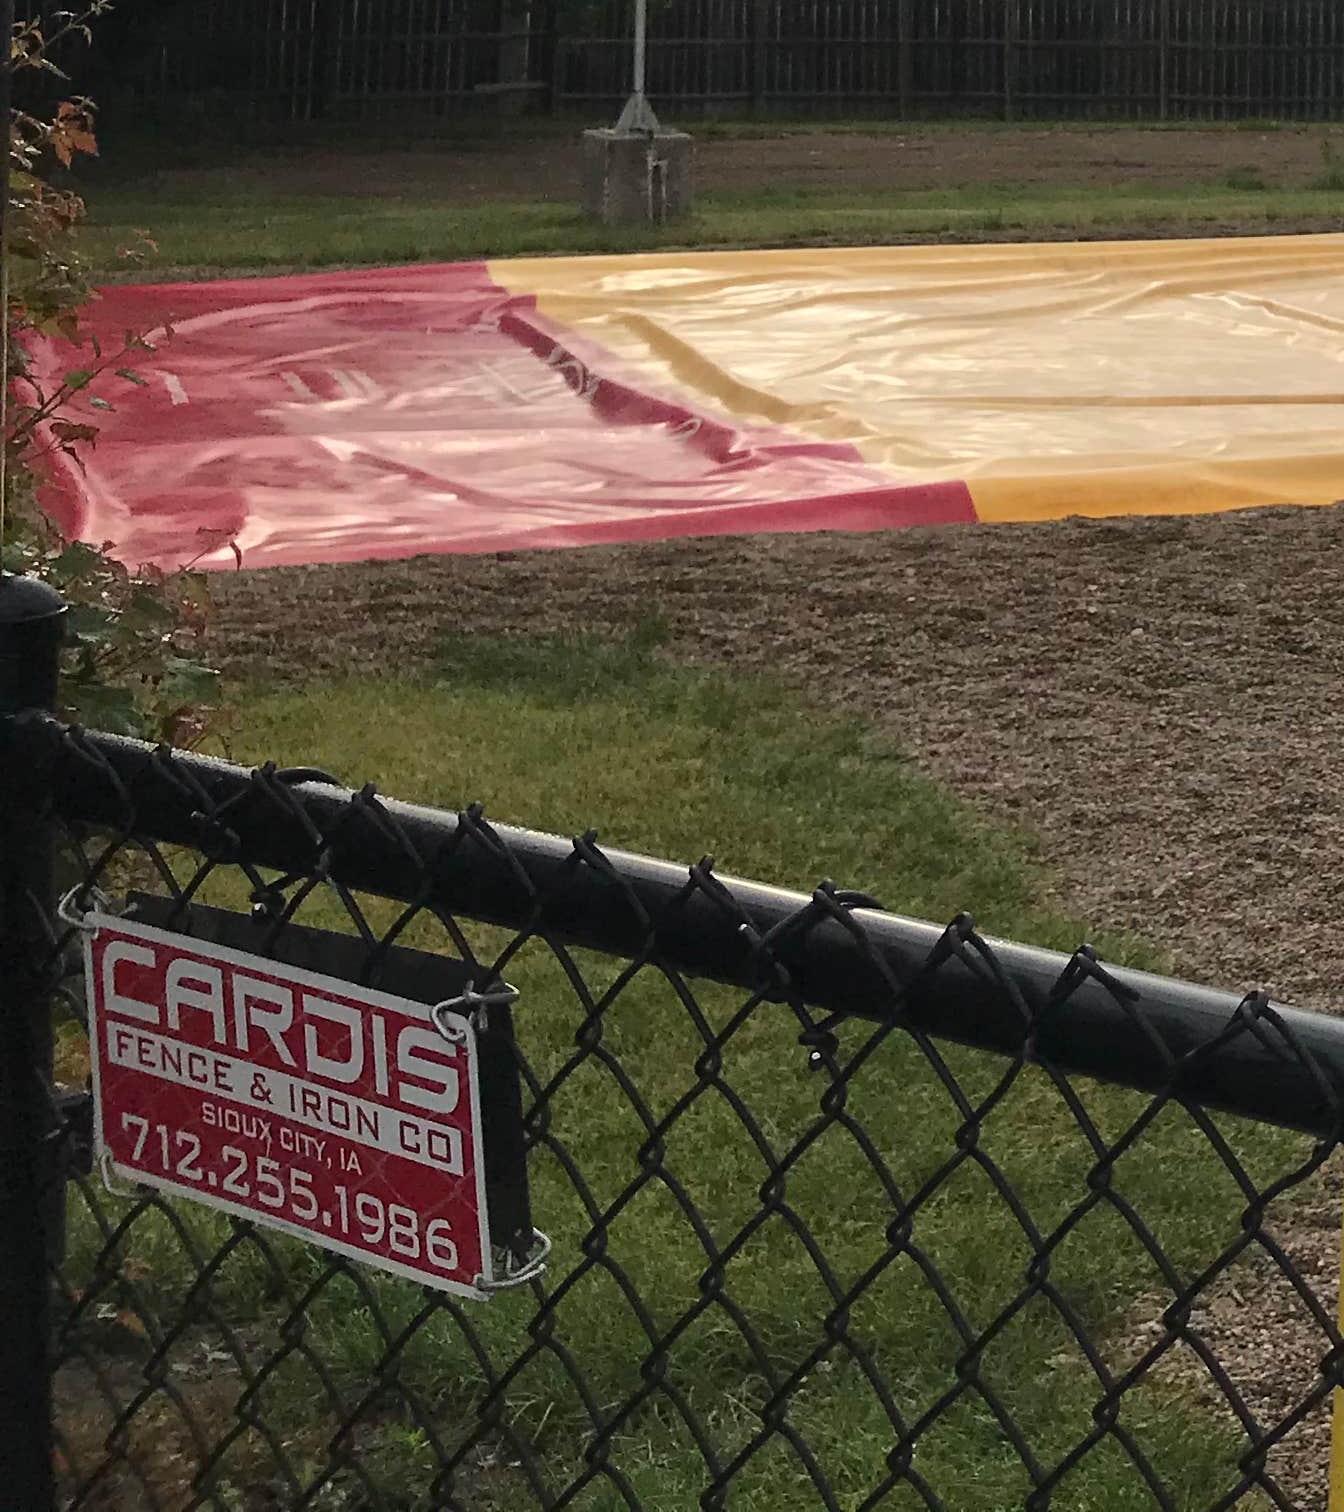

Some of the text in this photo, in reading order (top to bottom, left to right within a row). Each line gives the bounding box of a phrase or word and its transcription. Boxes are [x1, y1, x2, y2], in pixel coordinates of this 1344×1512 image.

[102, 940, 459, 1114] CARDIS
[116, 1029, 452, 1164] FENCE & IRON CO
[121, 1111, 459, 1271] 712.255.1986
[202, 1101, 363, 1176] SIOUX CITY, IA
